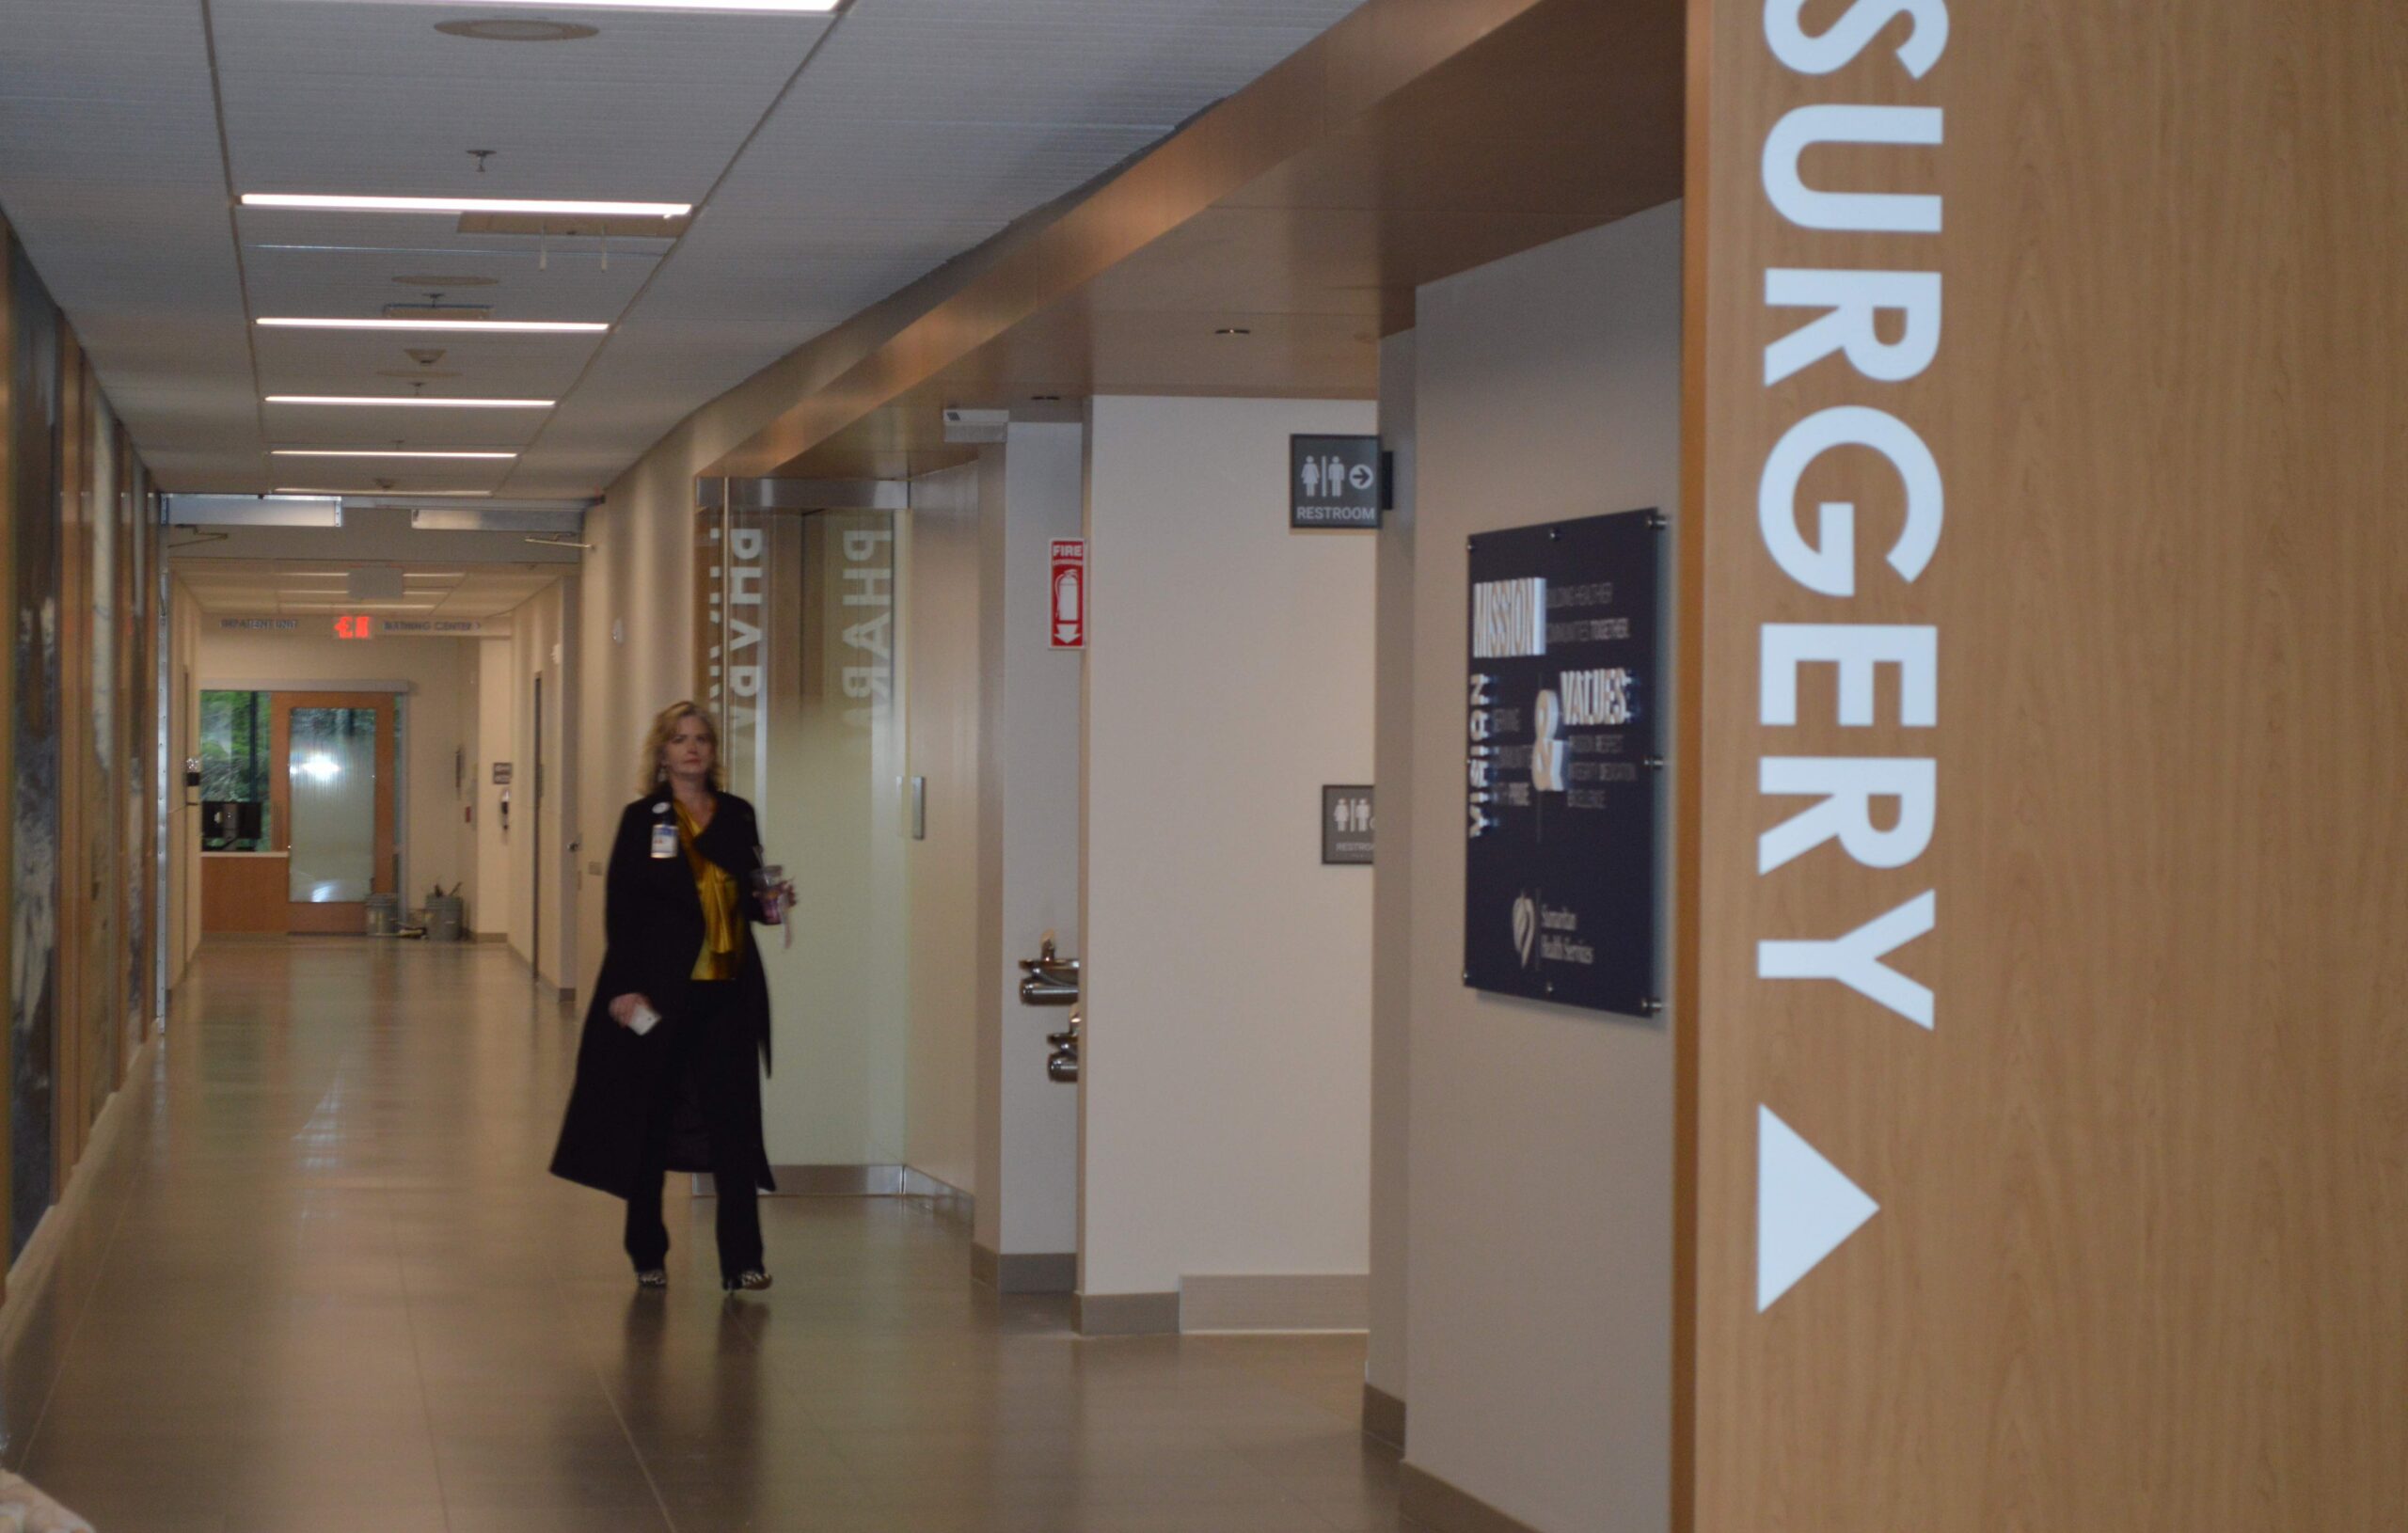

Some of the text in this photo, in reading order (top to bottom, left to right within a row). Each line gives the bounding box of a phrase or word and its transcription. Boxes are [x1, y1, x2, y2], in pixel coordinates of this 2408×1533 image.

[1296, 506, 1375, 521] RESTROOM
[1757, 0, 1949, 1031] SURGERY
[1053, 545, 1083, 557] FIRE
[1473, 577, 1545, 658] MISSION
[1560, 668, 1627, 726] VALUES
[1469, 672, 1490, 838] VISION
